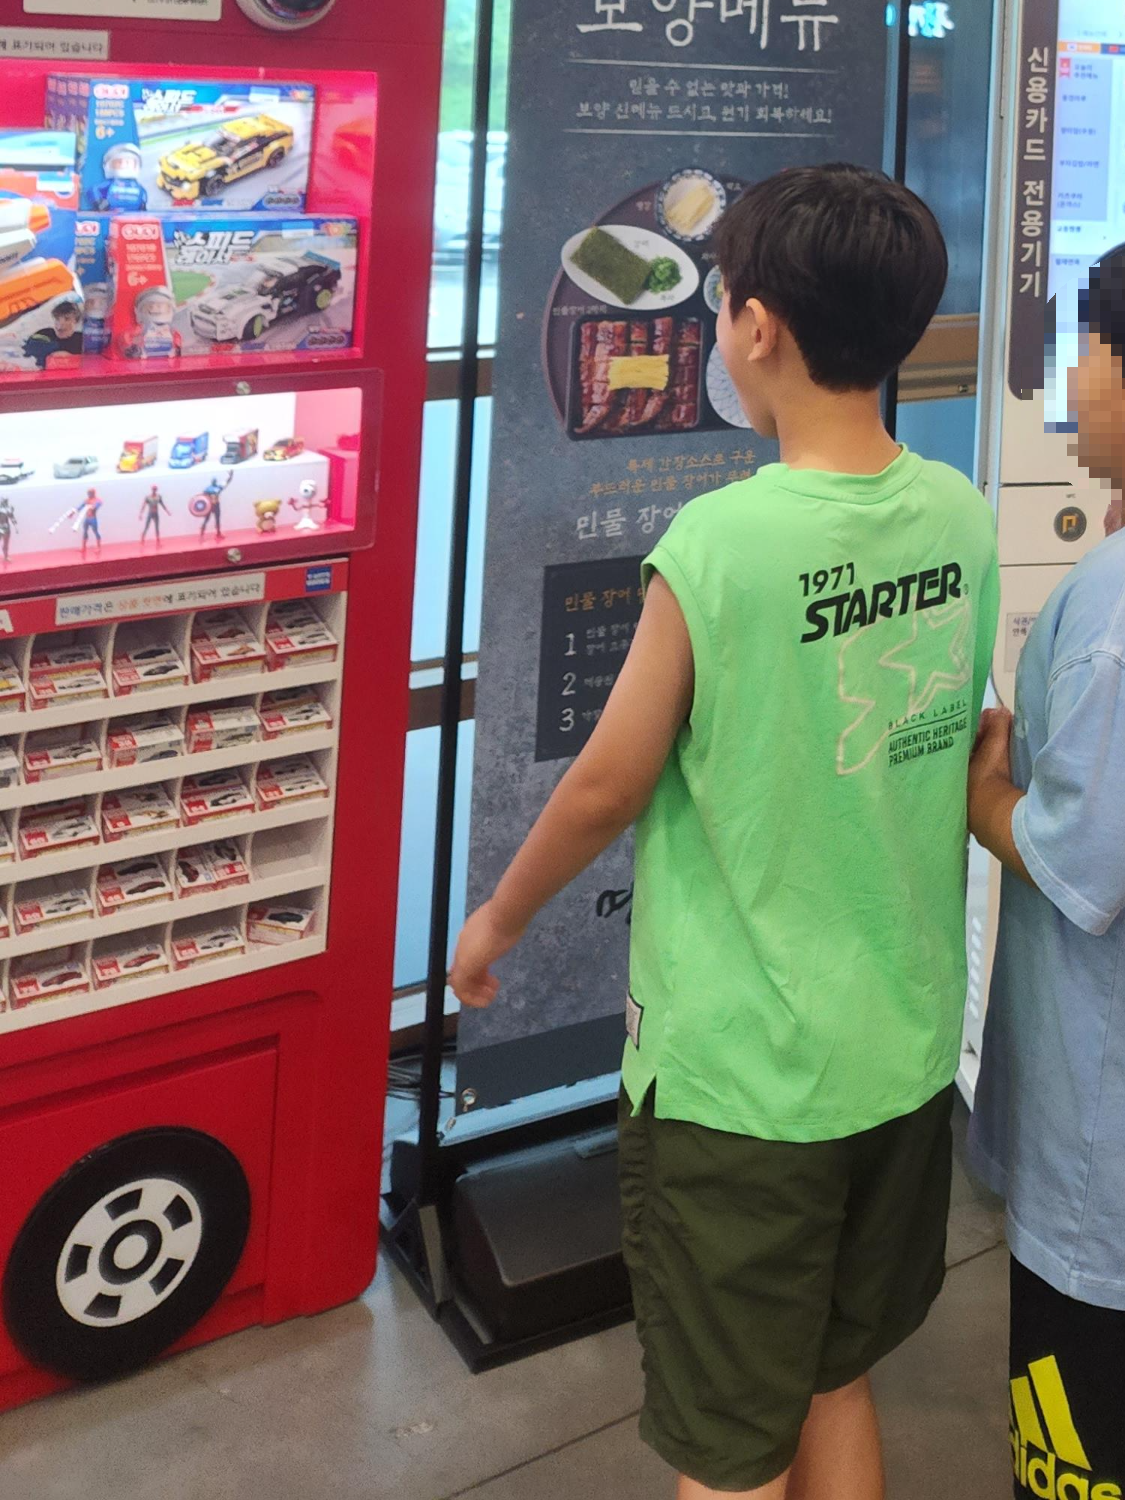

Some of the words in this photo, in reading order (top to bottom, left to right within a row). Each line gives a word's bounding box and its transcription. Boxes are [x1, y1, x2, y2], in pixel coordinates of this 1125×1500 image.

[664, 78, 681, 96] 수
[576, 101, 611, 120] 보양
[616, 101, 663, 120] 신메뉴
[1023, 47, 1048, 161] 신용카드
[1019, 180, 1045, 298] 전용기기
[659, 453, 726, 472] 간장소스로
[729, 449, 756, 465] 구운
[589, 478, 645, 498] 부드러운
[651, 475, 677, 492] 민물
[682, 471, 722, 489] 장어가
[576, 508, 627, 540] 민물
[798, 562, 855, 597] 1971
[565, 591, 596, 612] 민물
[602, 587, 631, 608] 장어
[800, 562, 962, 643] STARTER
[564, 633, 577, 656] 1
[561, 672, 576, 696] 2
[559, 708, 575, 732] 3
[888, 711, 925, 730] BLACK
[933, 699, 967, 718] LABEL
[888, 730, 931, 753] AUTHENTIC
[932, 717, 967, 742] HERITAGE
[888, 746, 925, 768] PREMIUM
[926, 737, 954, 756] BRAND
